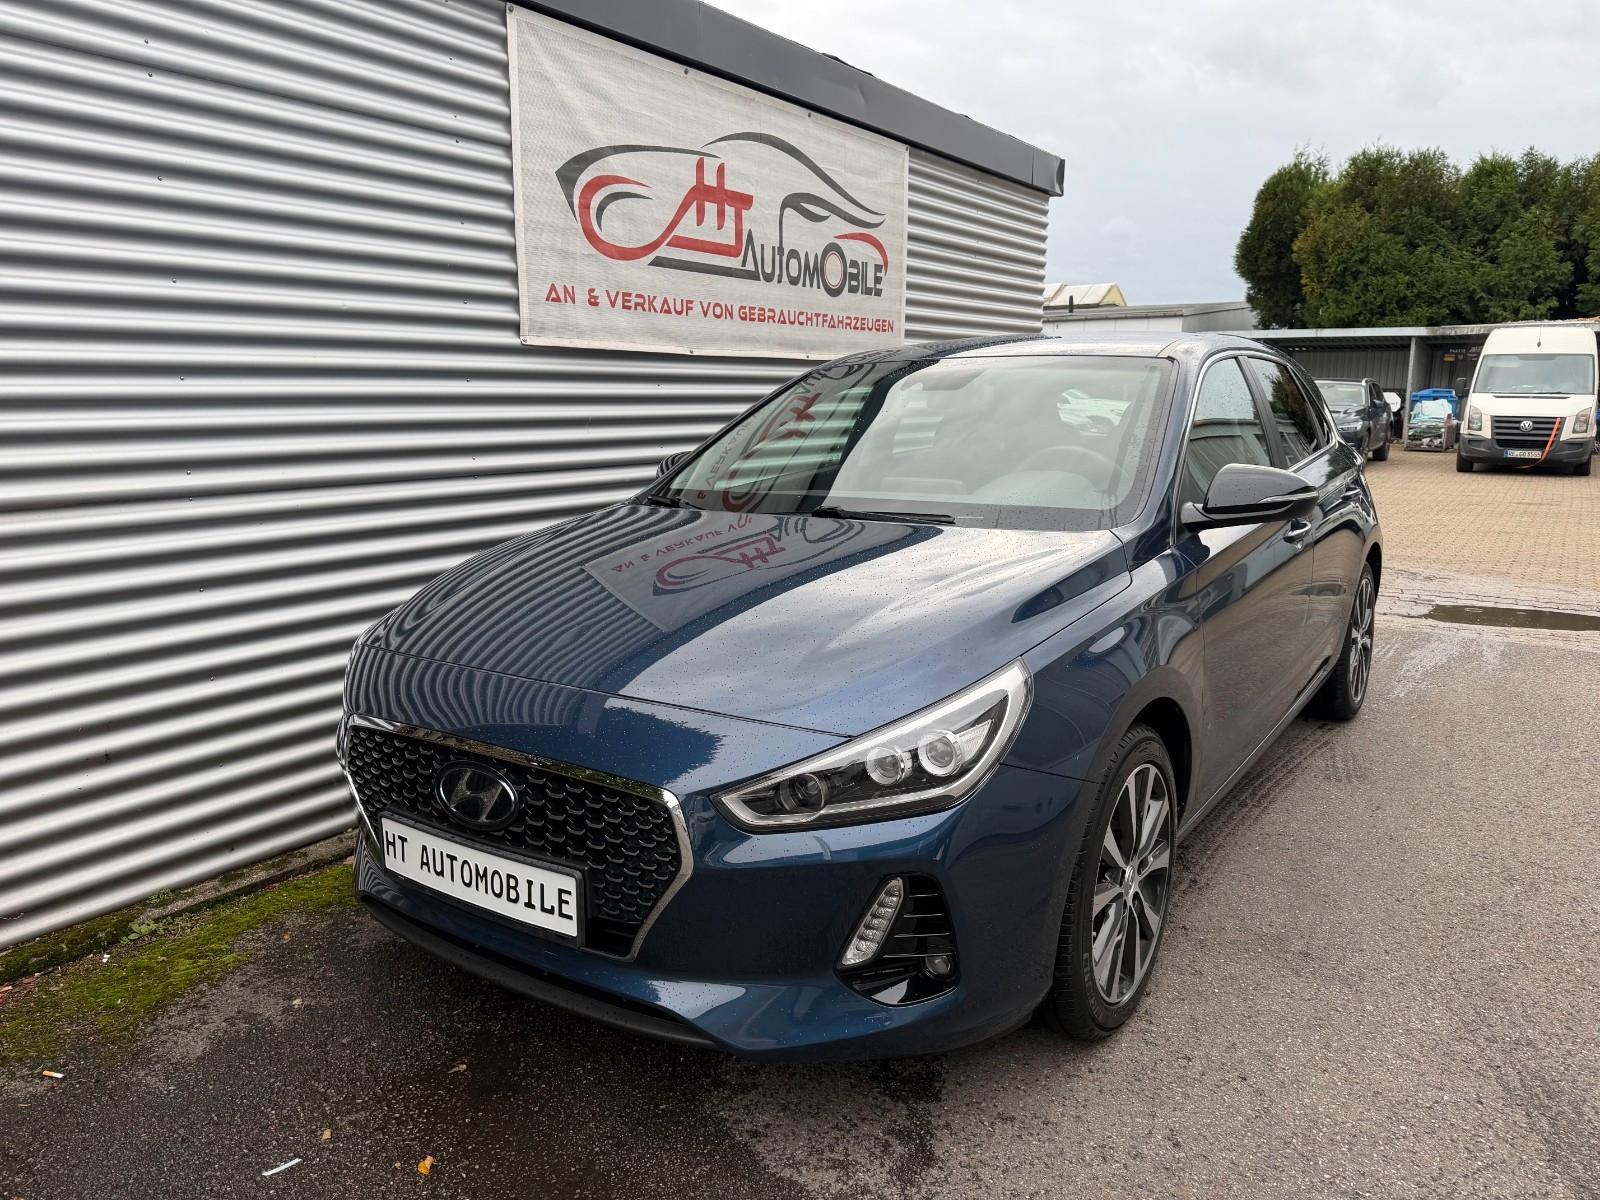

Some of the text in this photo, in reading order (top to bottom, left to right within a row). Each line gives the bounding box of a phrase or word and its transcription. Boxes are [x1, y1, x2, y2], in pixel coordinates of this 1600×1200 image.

[545, 283, 894, 333] AN & VERKAUF VON GEBRAUCHTFAHRZEUGEN
[384, 830, 574, 921] HT AUTOMOBILE
